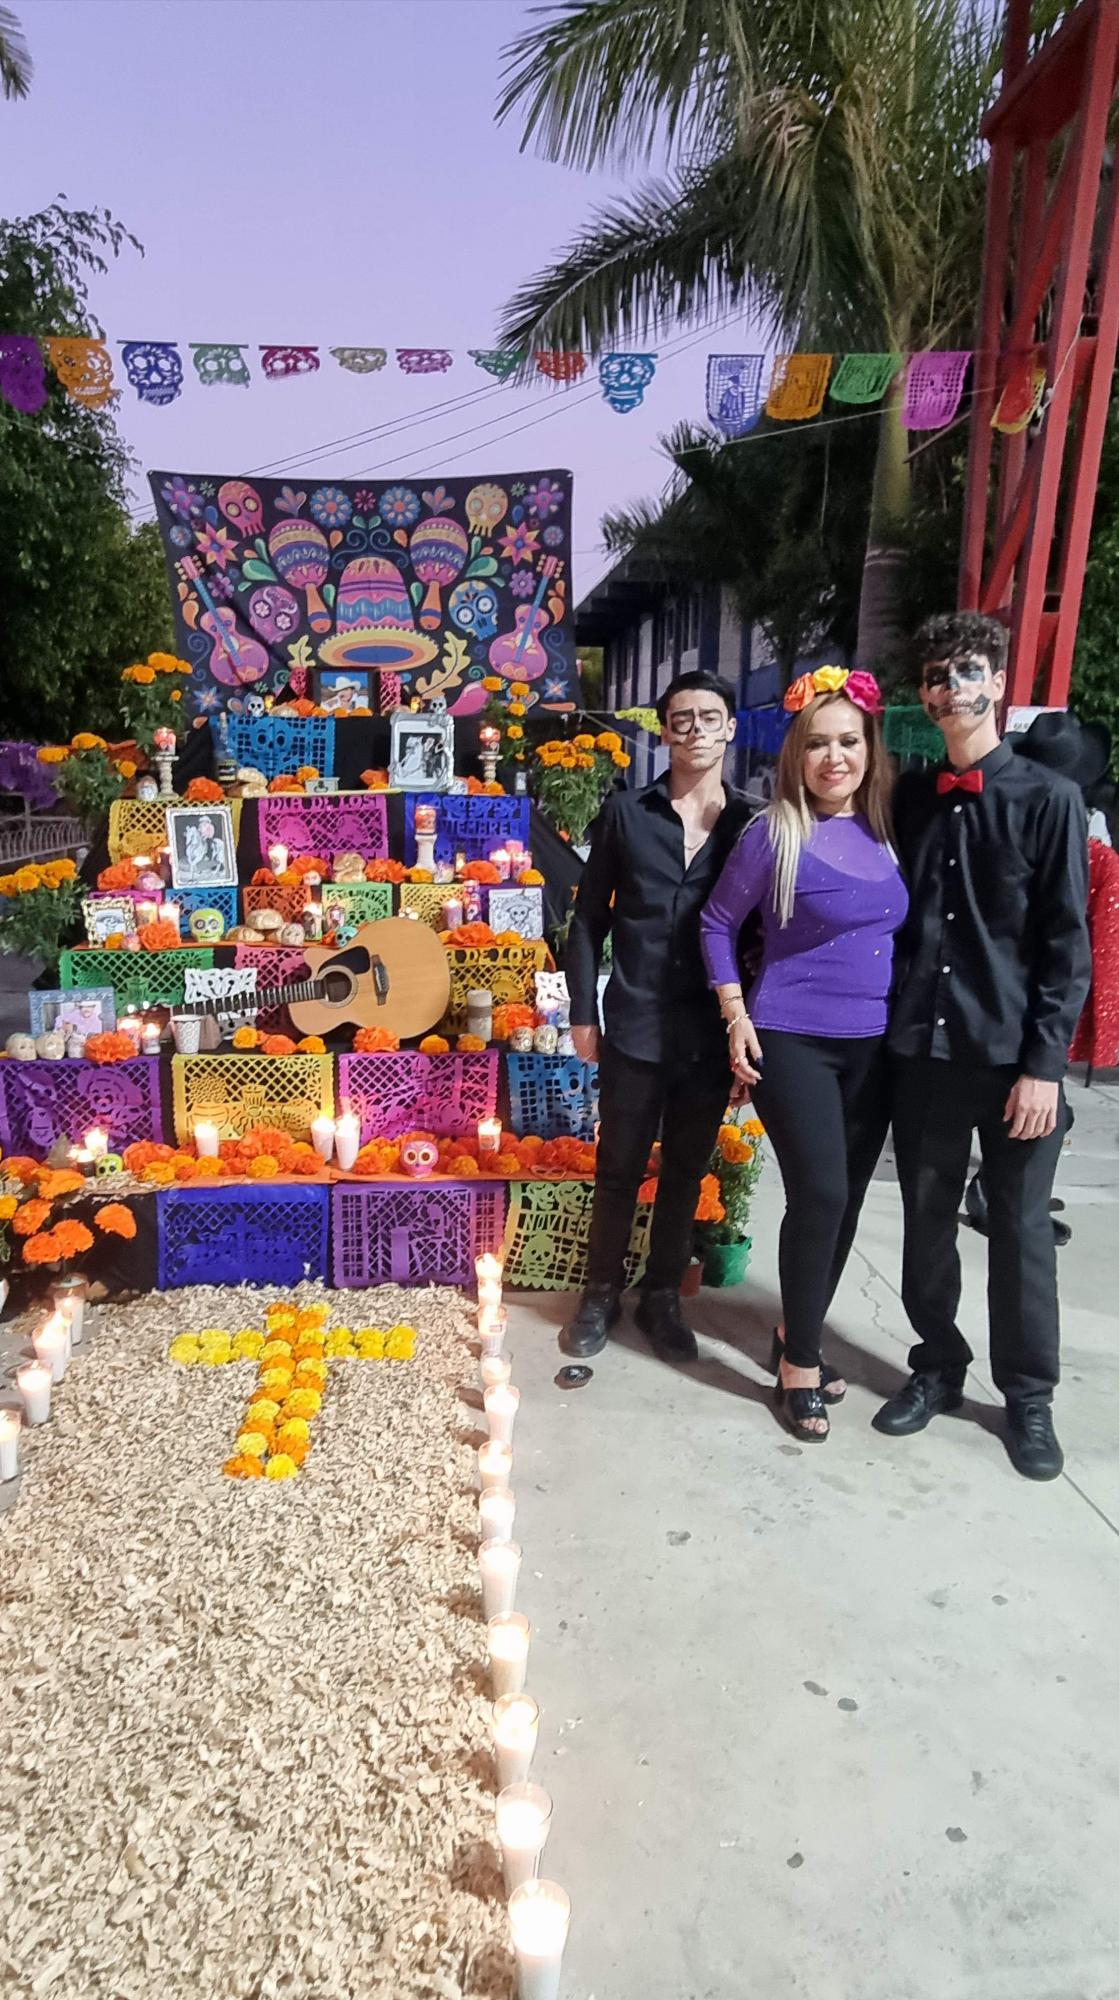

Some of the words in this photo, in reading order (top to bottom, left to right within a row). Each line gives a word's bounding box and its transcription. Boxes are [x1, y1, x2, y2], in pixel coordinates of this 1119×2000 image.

[339, 795, 376, 810] LOS
[442, 819, 510, 836] VIEMBRE
[465, 947, 491, 964] DE
[498, 946, 536, 963] LOS
[523, 1213, 591, 1237] NOVIEM
